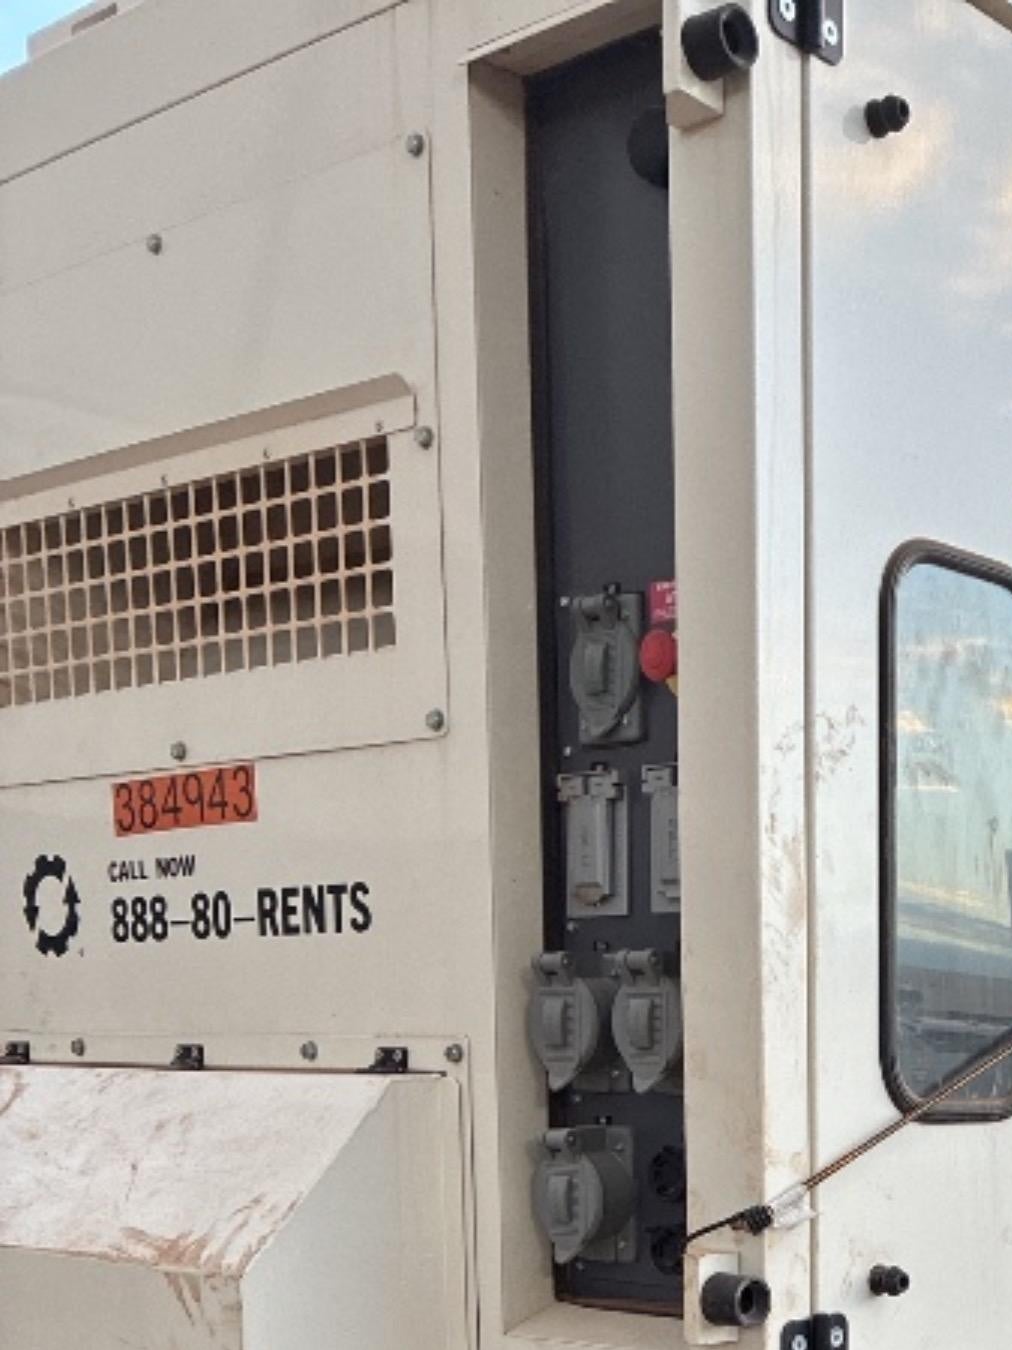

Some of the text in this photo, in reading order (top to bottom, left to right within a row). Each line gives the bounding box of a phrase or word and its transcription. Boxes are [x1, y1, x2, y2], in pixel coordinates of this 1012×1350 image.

[115, 763, 255, 833] 384943
[107, 855, 196, 883] CALL NOW
[111, 881, 373, 943] 888-80-RENTS
